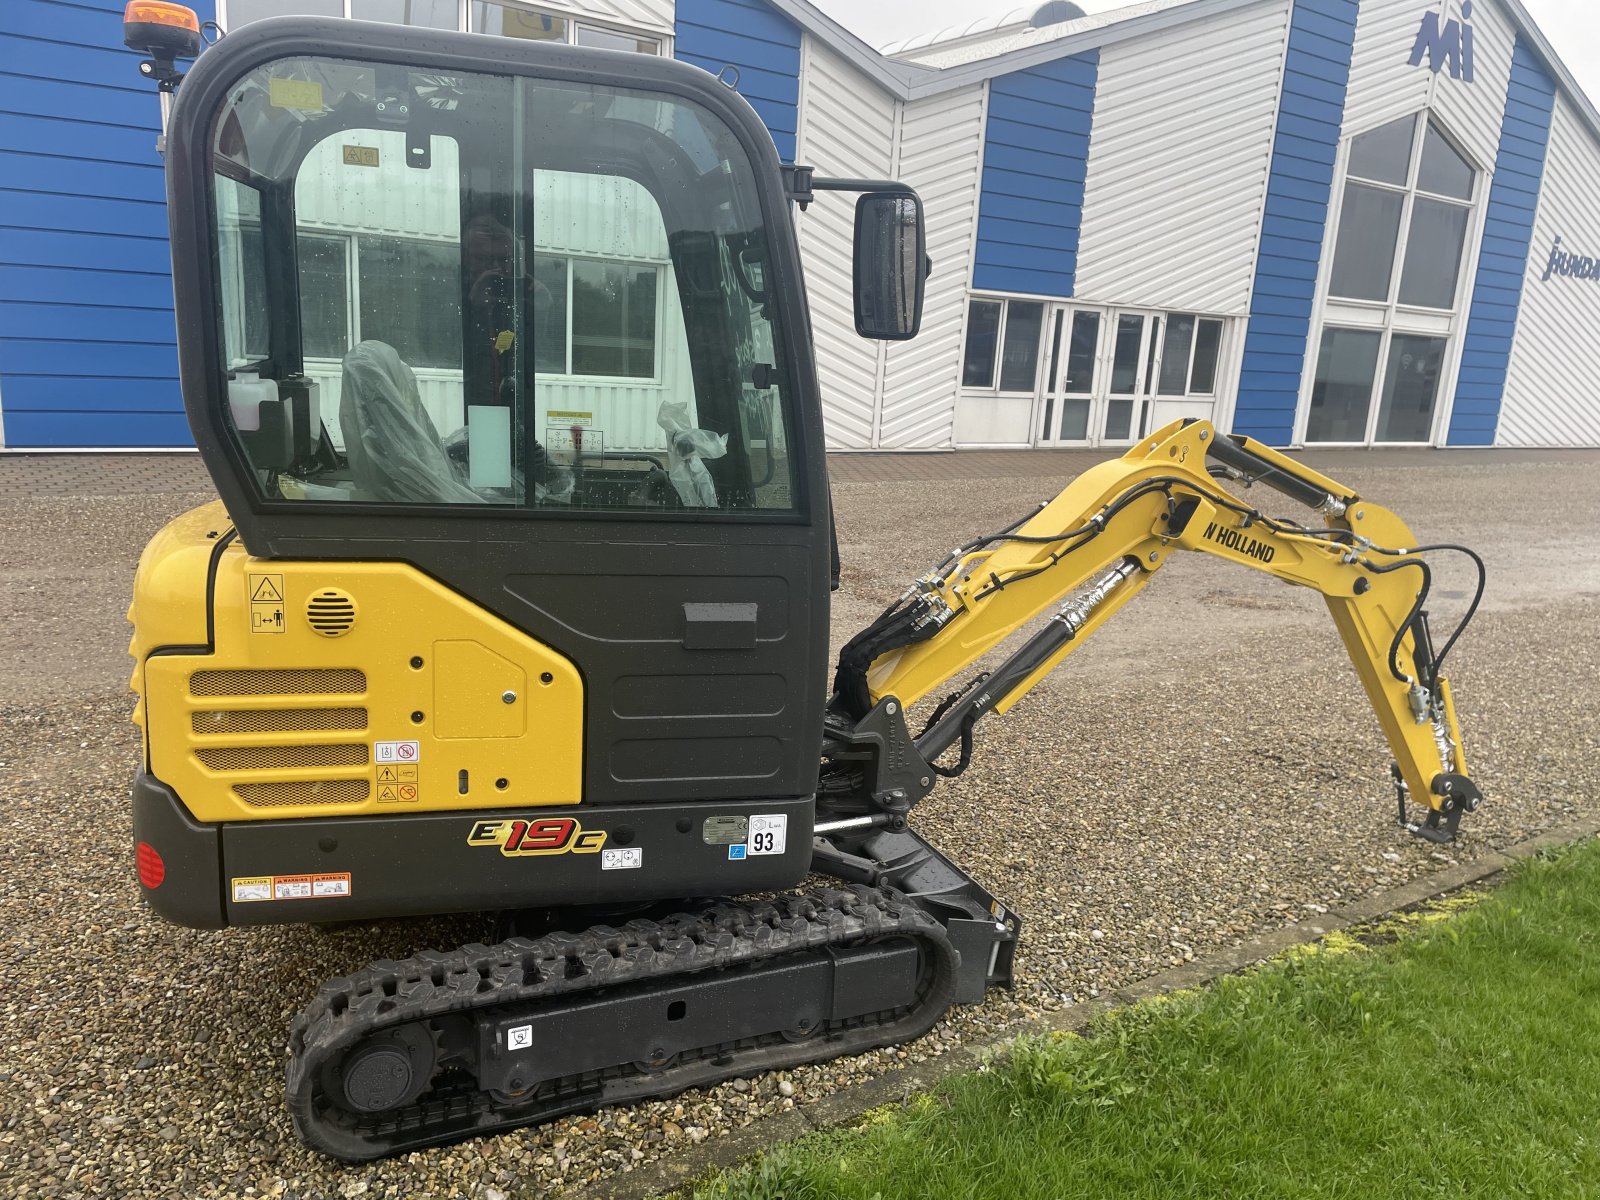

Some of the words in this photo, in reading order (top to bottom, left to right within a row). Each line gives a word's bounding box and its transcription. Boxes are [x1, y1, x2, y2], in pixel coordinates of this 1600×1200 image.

[1407, 0, 1474, 83] Mi
[1202, 521, 1218, 540] N
[1215, 526, 1275, 563] HOLLAND
[753, 832, 774, 852] 93
